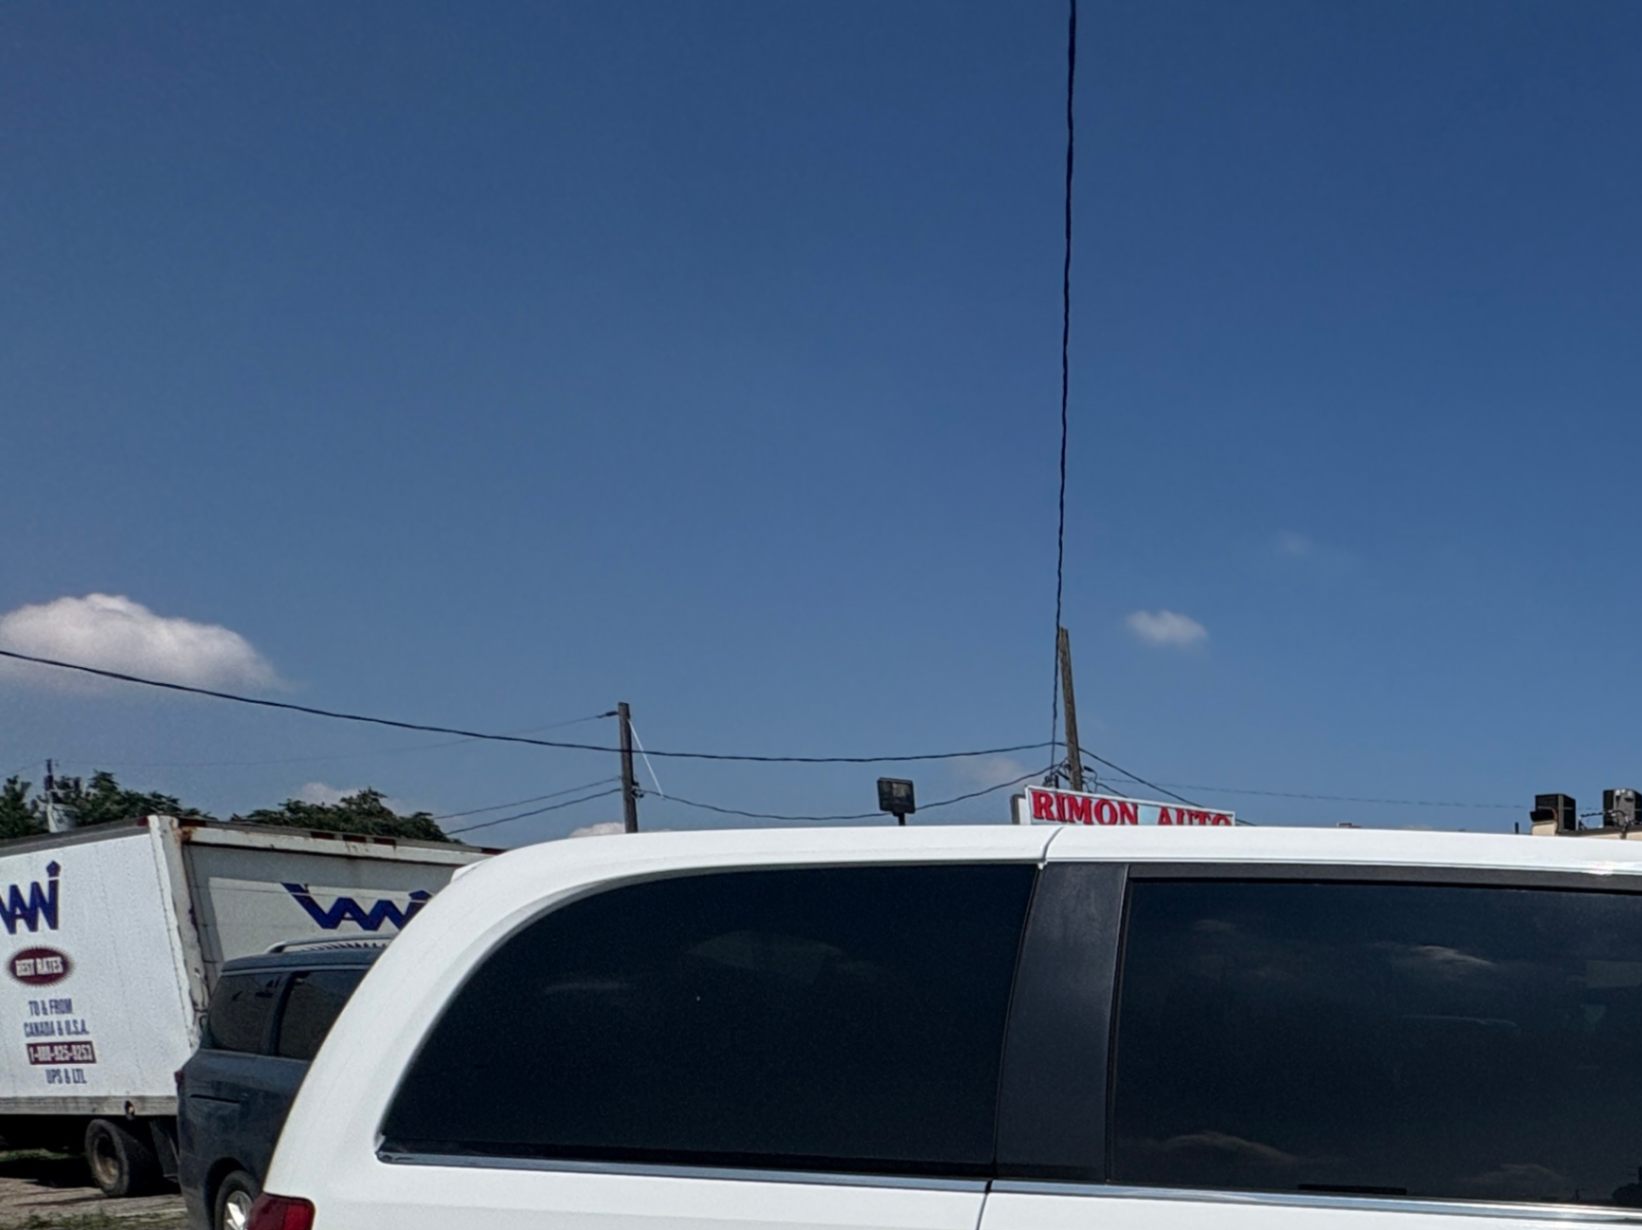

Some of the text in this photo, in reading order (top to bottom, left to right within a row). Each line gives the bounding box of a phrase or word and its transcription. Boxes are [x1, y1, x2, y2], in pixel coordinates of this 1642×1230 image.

[1031, 790, 1138, 826] RIMON
[28, 1000, 40, 1016] TO
[49, 998, 73, 1014] FROM
[24, 1020, 56, 1037] CANADA
